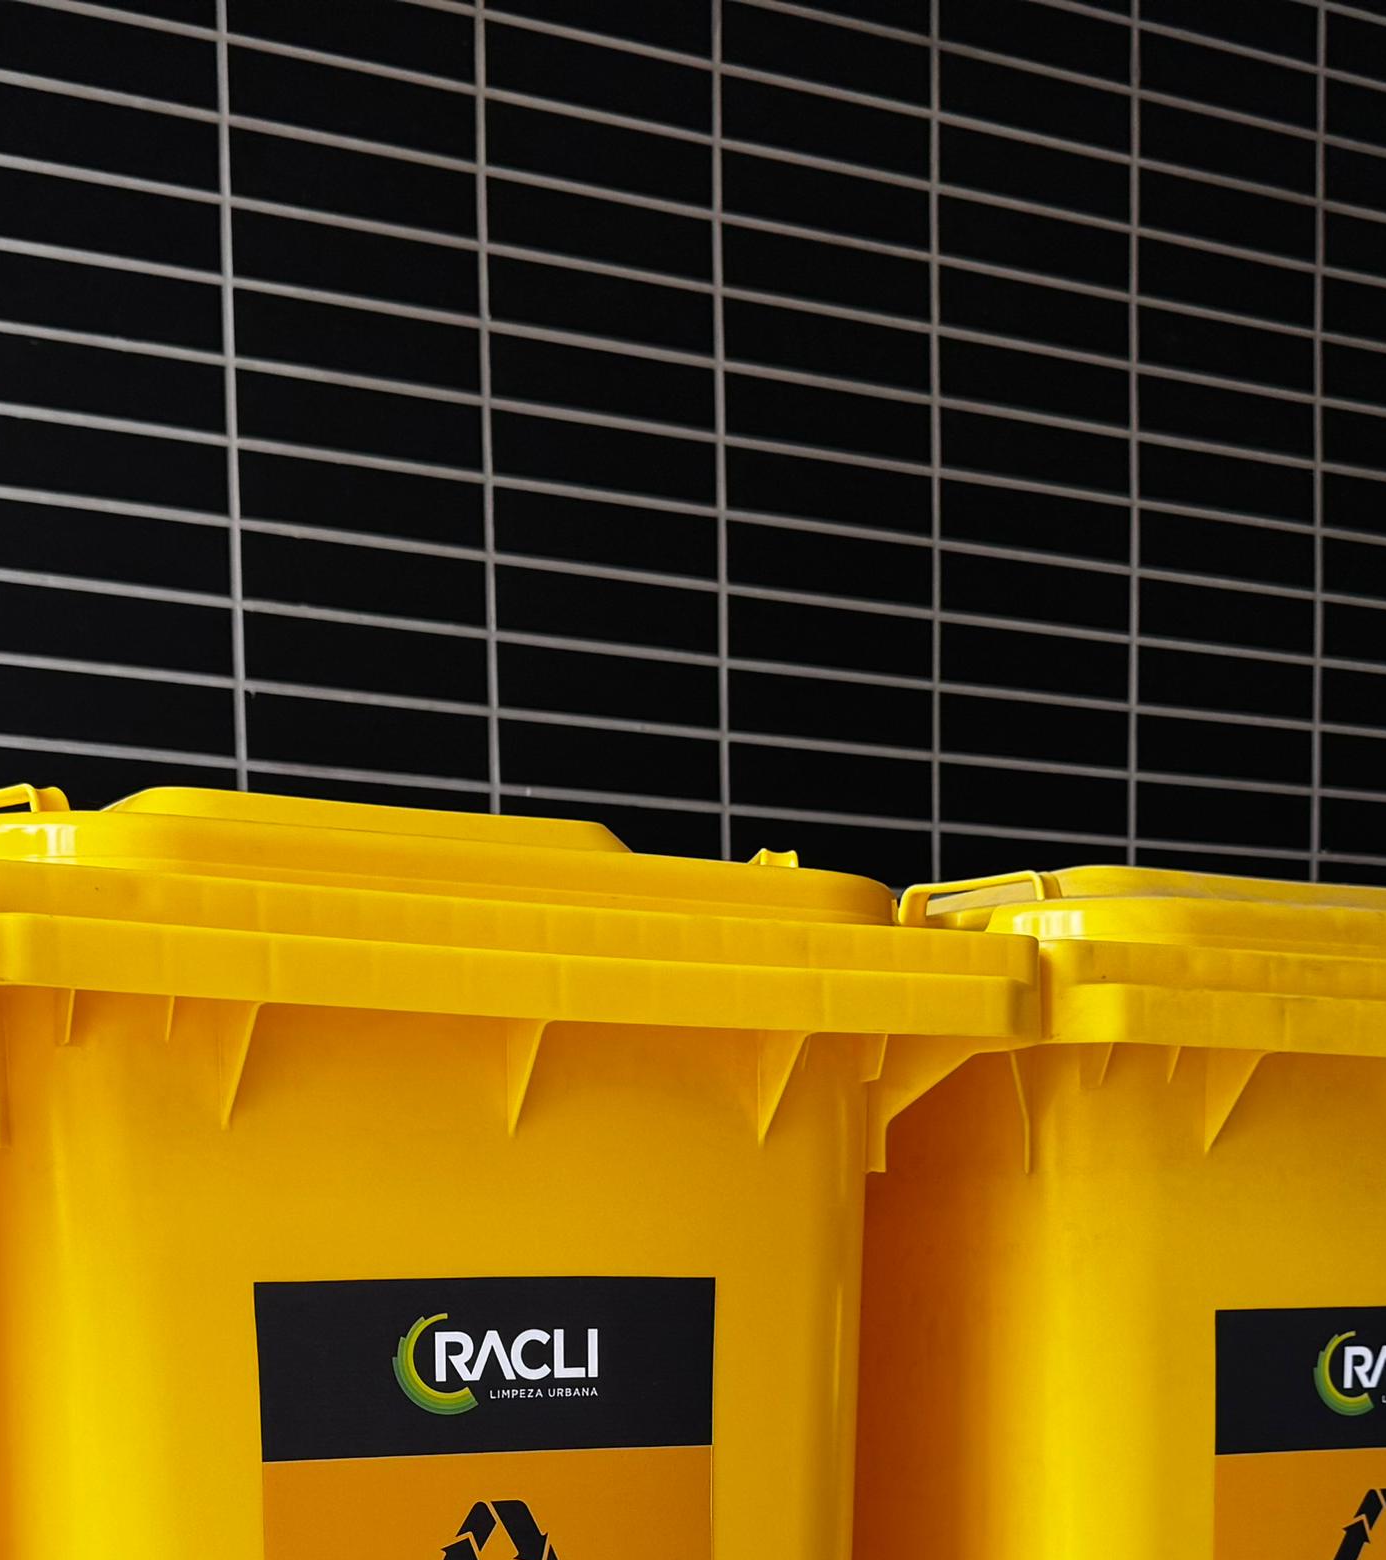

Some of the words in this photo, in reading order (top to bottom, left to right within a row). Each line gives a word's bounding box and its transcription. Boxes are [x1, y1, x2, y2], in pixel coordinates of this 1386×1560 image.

[434, 1328, 598, 1382] RACLI
[490, 1388, 543, 1399] LIMPEZA
[548, 1387, 598, 1397] URBANA
